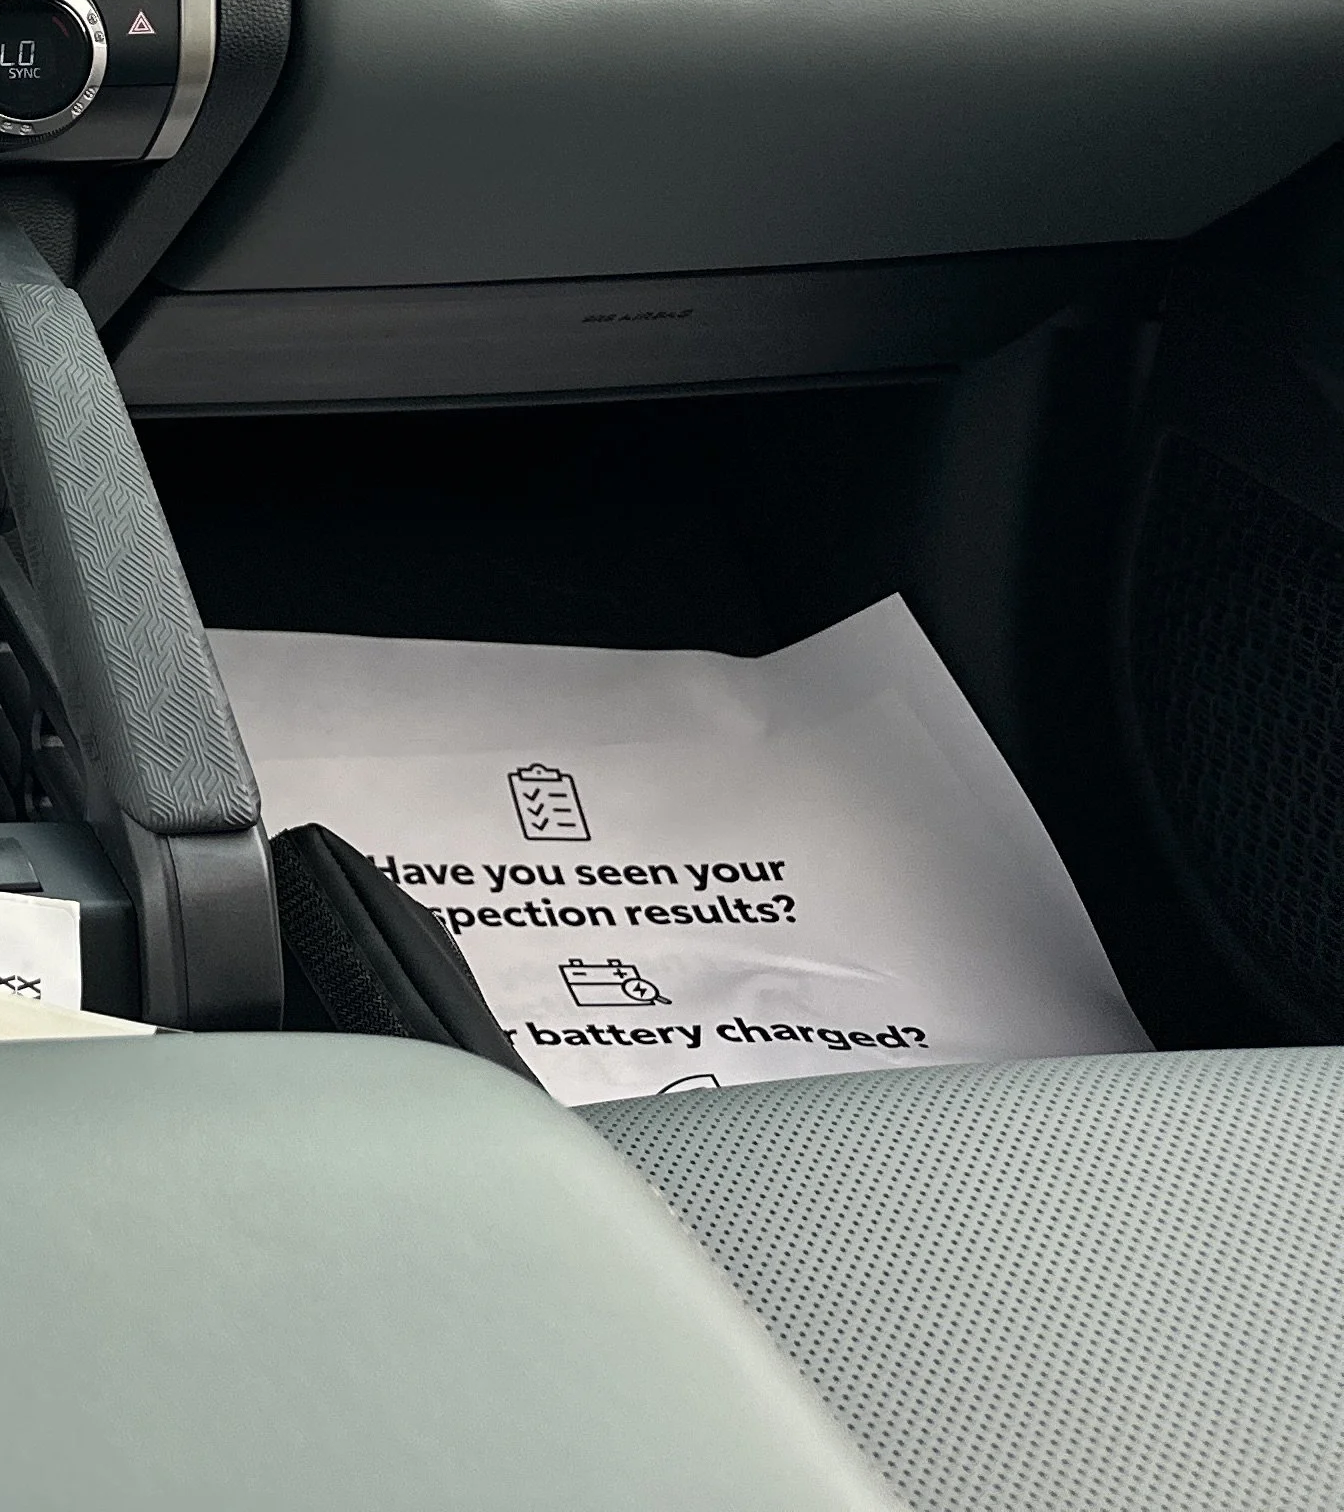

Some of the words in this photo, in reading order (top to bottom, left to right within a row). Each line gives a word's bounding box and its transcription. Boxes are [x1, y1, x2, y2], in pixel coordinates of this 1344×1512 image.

[8, 68, 40, 79] SYNC
[483, 861, 565, 893] you
[577, 860, 678, 885] seen
[684, 857, 785, 890] your
[626, 894, 798, 926] results?
[526, 1021, 703, 1048] battery
[715, 1017, 930, 1052] charged?
